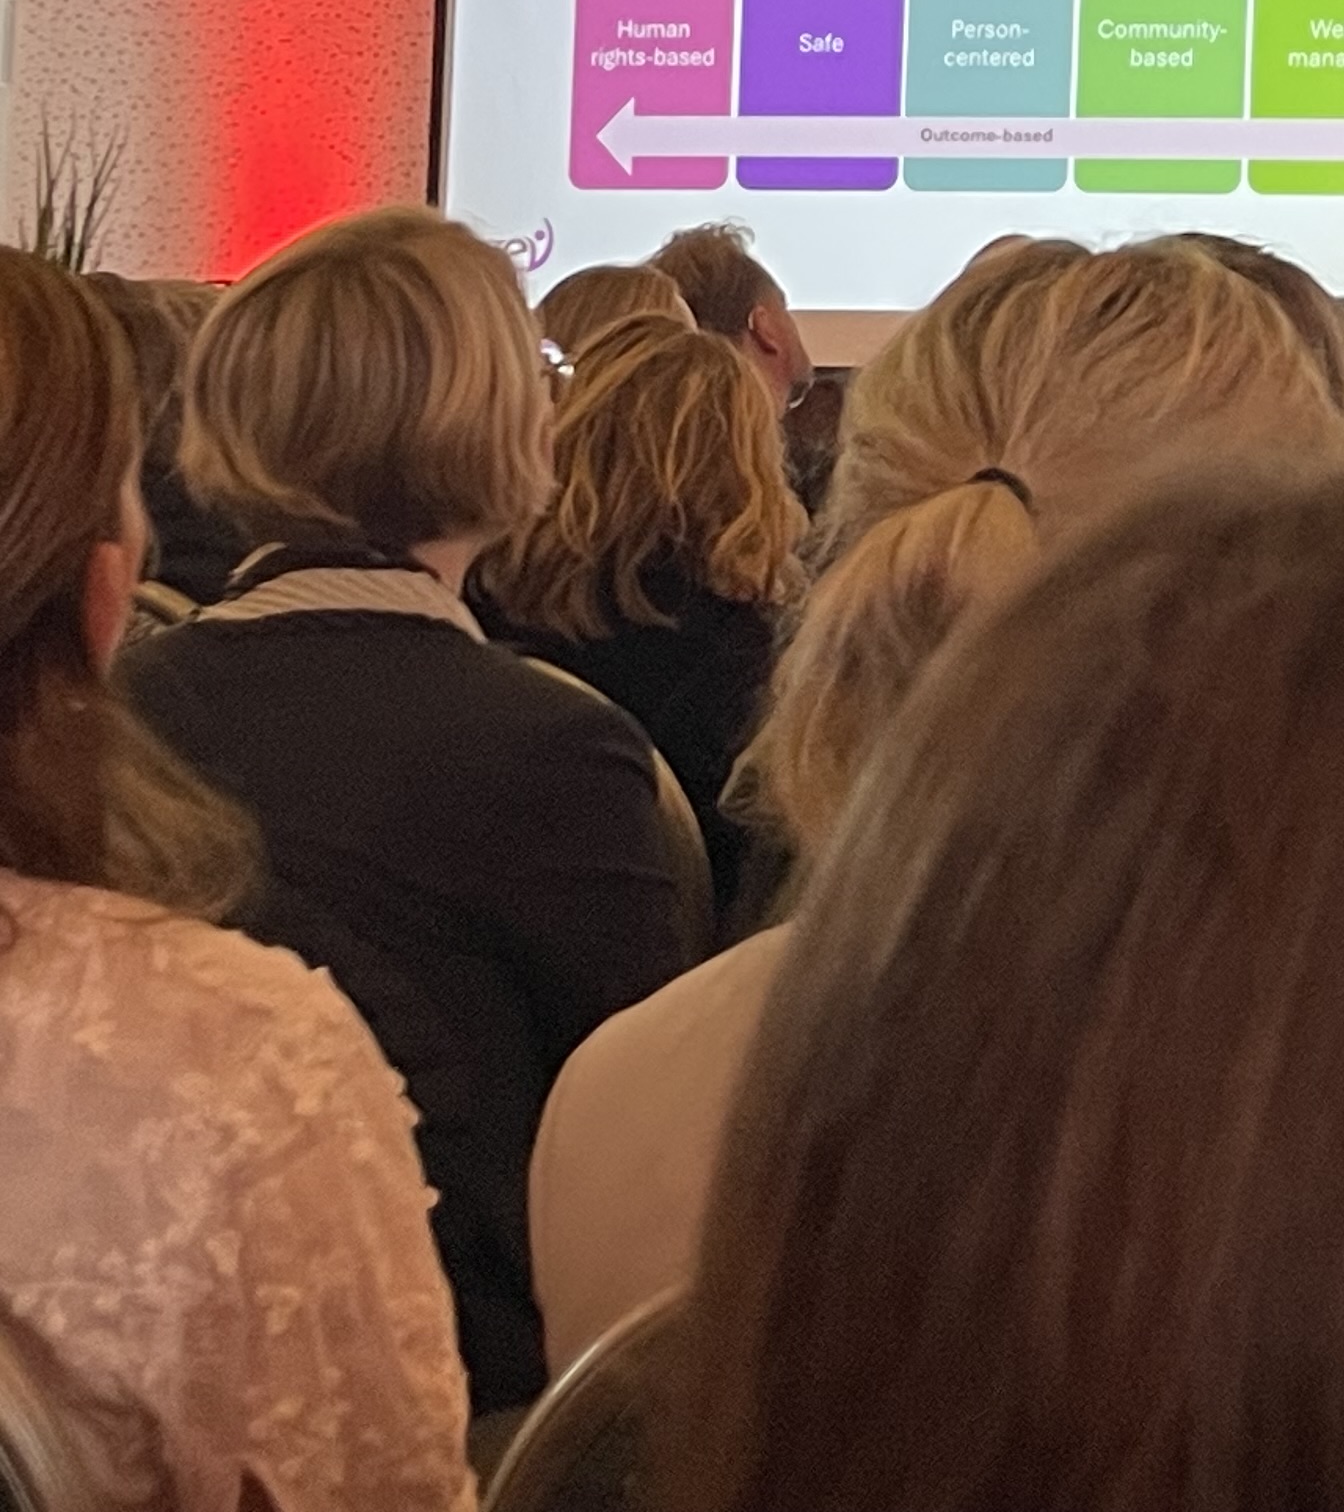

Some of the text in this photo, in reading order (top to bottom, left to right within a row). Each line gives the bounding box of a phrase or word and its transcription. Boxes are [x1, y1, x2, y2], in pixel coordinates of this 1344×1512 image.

[617, 18, 691, 39] Human
[951, 19, 1029, 39] Person-
[1097, 18, 1228, 43] Community-
[798, 32, 845, 53] Safe
[590, 46, 715, 72] rights-based
[943, 47, 1035, 67] centered
[1130, 47, 1193, 68] based
[920, 127, 1054, 143] Outcome-based
